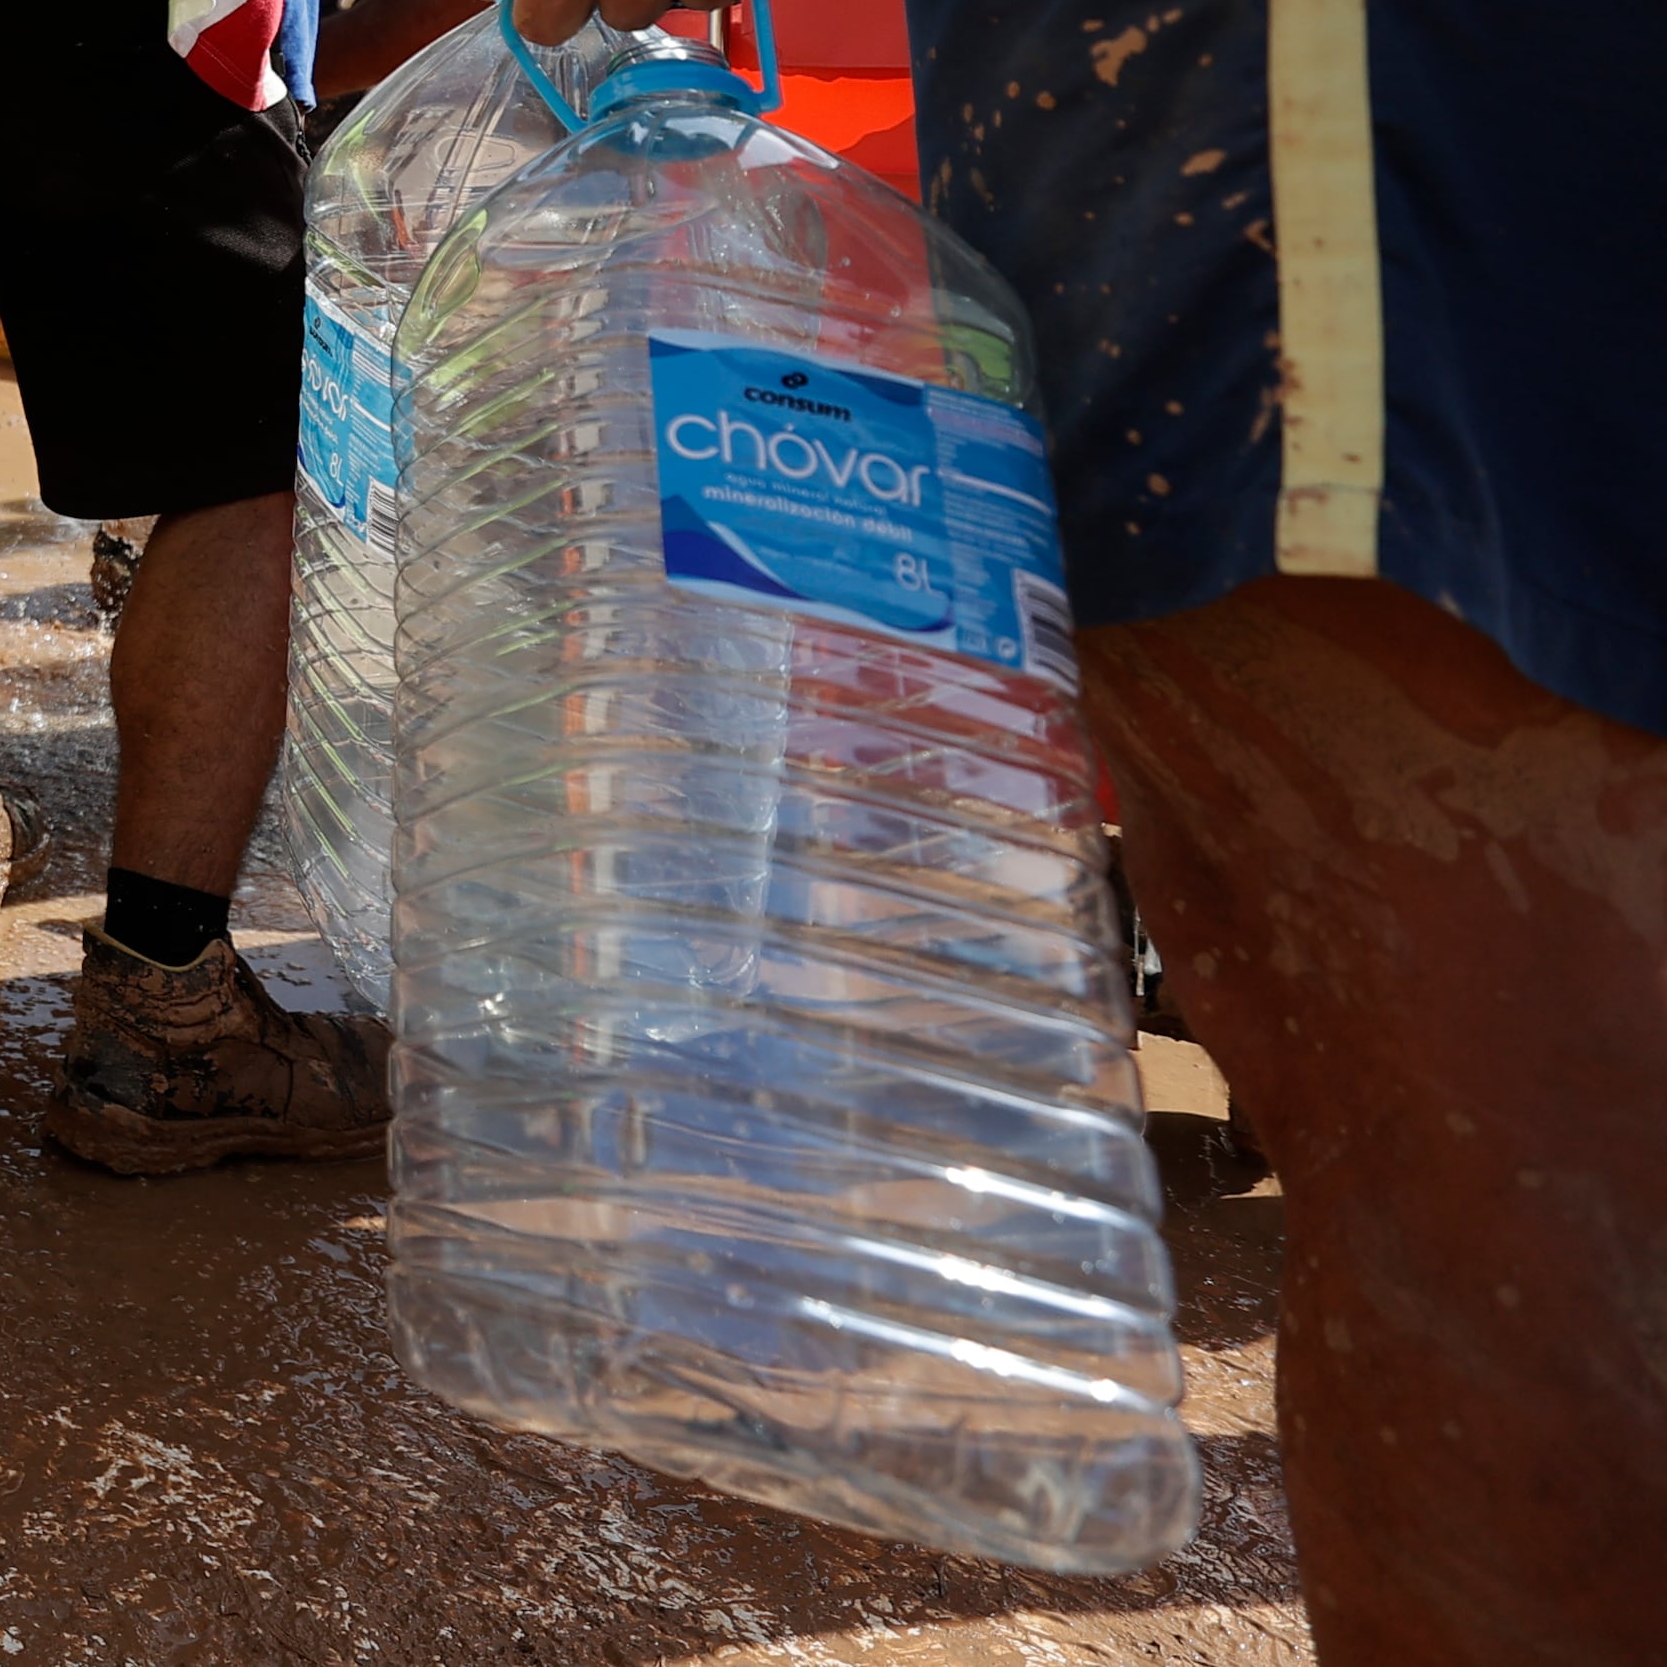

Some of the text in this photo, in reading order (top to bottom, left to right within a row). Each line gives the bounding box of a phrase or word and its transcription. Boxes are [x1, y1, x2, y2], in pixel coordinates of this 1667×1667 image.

[744, 386, 852, 422] consum
[329, 451, 345, 487] 8L
[667, 410, 931, 508] chóvar
[724, 472, 767, 490] agua
[894, 551, 947, 600] 8L
